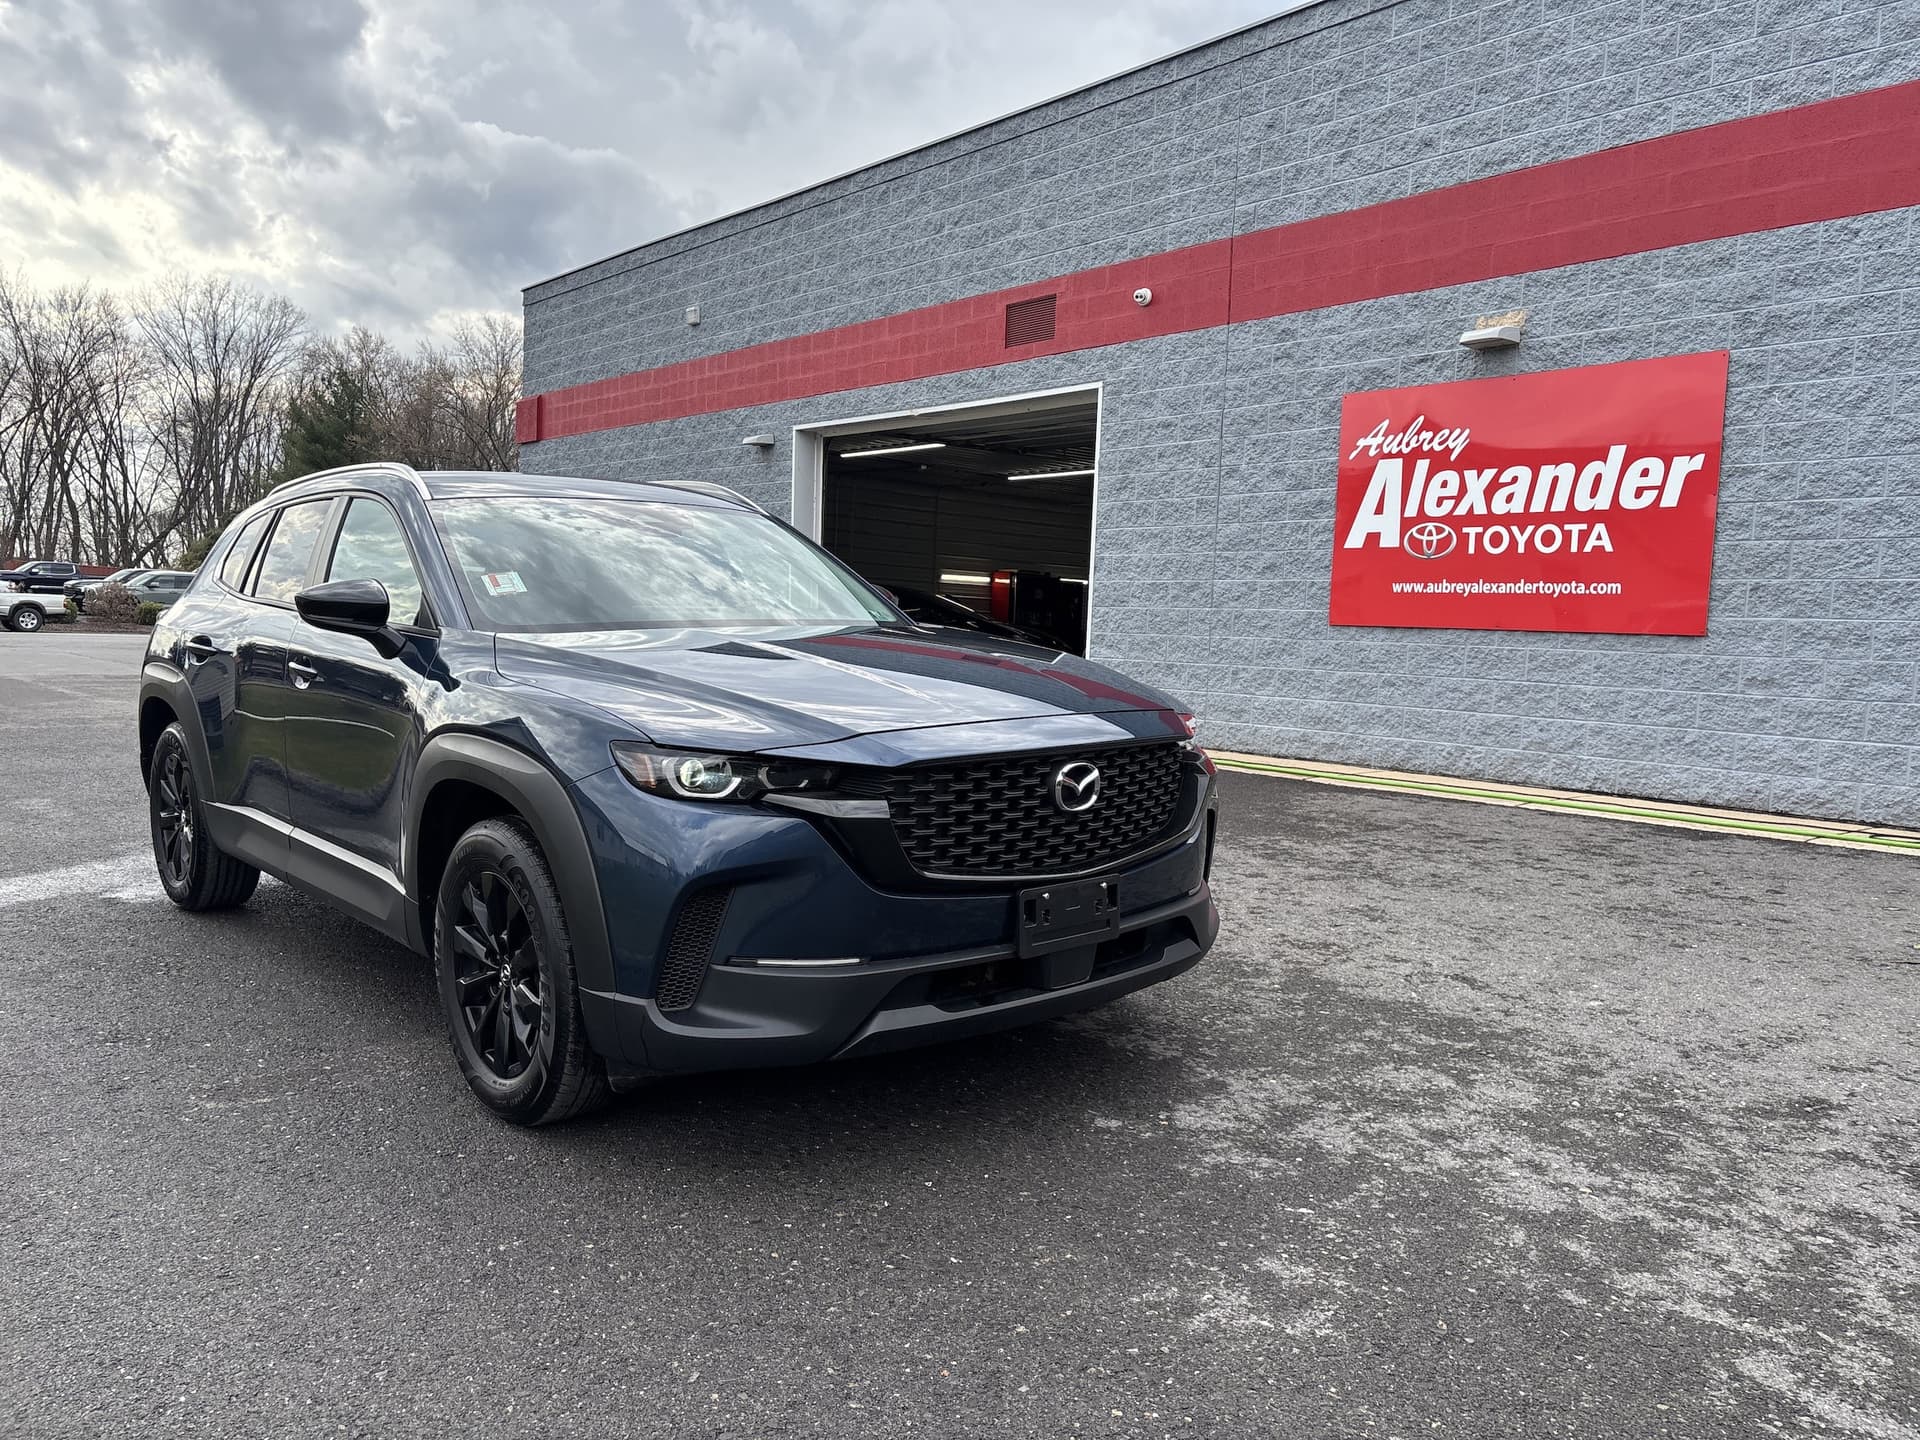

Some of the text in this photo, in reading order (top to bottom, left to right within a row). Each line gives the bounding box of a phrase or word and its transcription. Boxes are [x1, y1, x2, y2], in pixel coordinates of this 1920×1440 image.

[1349, 415, 1470, 461] Aubrey
[1343, 444, 1706, 549] Alexander
[1462, 523, 1614, 555] TOYOTA
[1392, 579, 1622, 598] www.aubreyalexandertoyota.com
